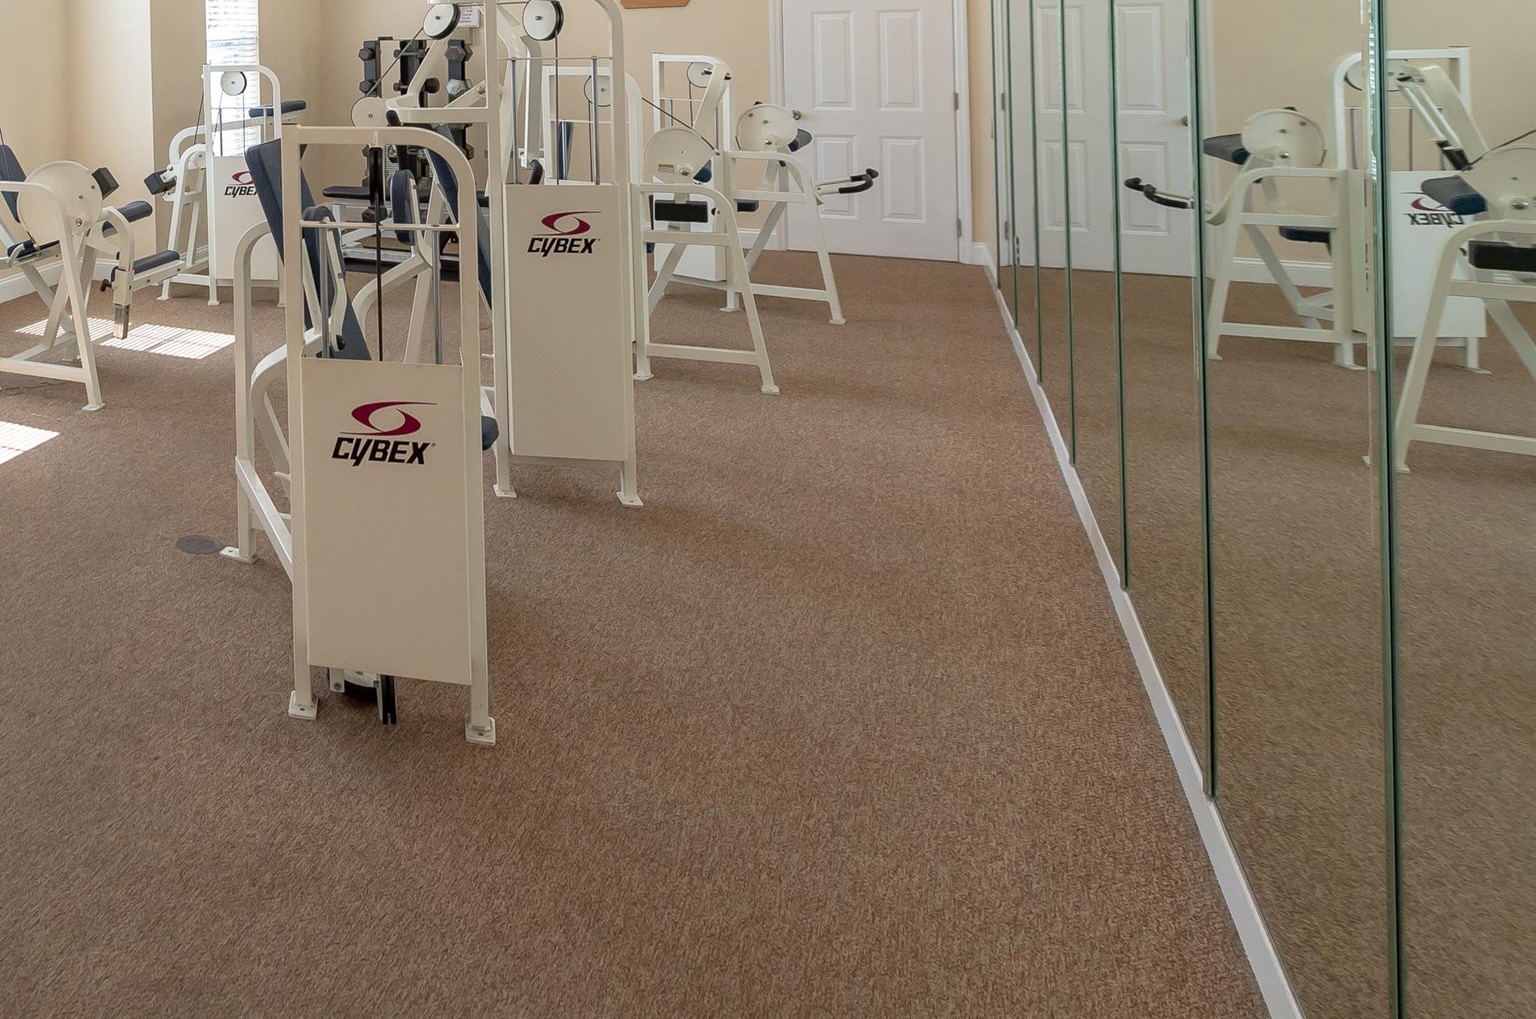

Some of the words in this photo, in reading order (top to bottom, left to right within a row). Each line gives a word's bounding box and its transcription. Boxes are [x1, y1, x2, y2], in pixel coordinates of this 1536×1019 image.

[224, 186, 258, 199] CYBE
[527, 237, 597, 258] CYBEX
[331, 437, 431, 467] CYBEX
